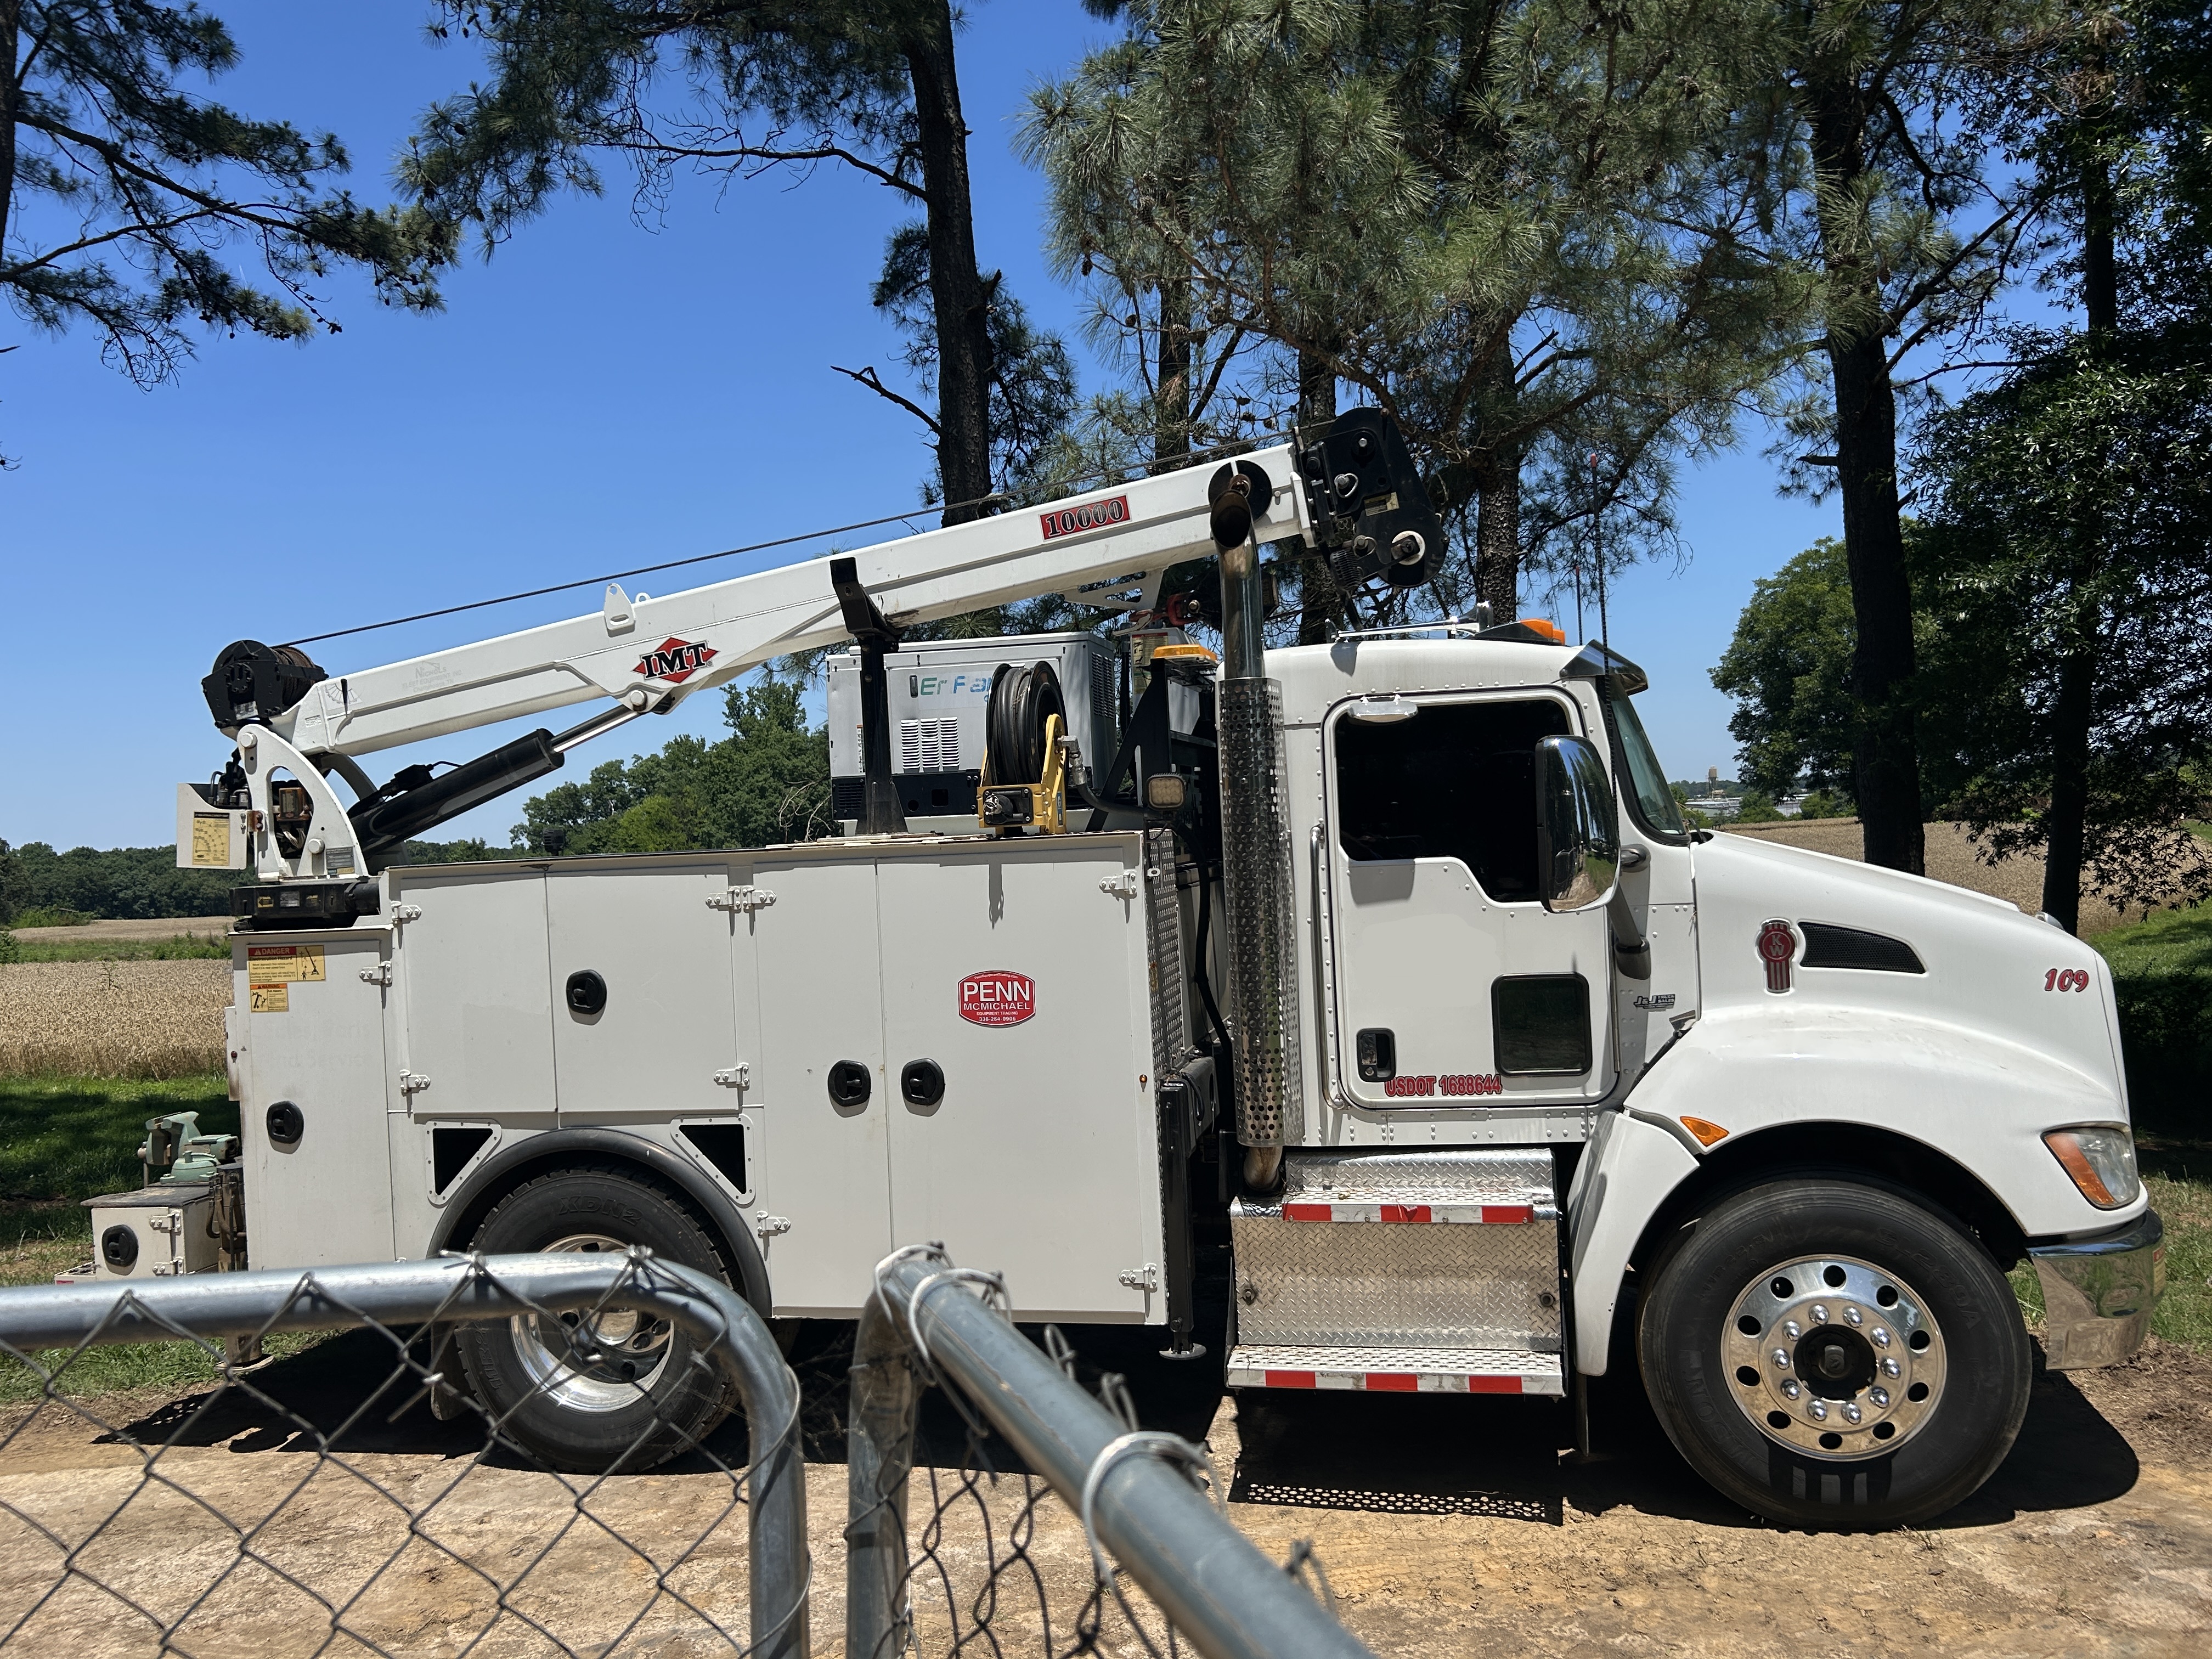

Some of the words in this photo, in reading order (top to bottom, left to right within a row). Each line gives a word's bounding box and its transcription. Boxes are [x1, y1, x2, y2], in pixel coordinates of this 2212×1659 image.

[1045, 499, 1125, 537] 10000
[640, 640, 708, 680] IMT
[1769, 945, 1785, 956] W
[1771, 934, 1782, 945] K
[963, 980, 1030, 1002] PENN
[2044, 968, 2089, 993] 109
[963, 1002, 1031, 1011] MCMICHAEL
[1385, 1076, 1437, 1097] USDOT
[1439, 1074, 1503, 1096] 1688644
[558, 1195, 644, 1227] XDN2
